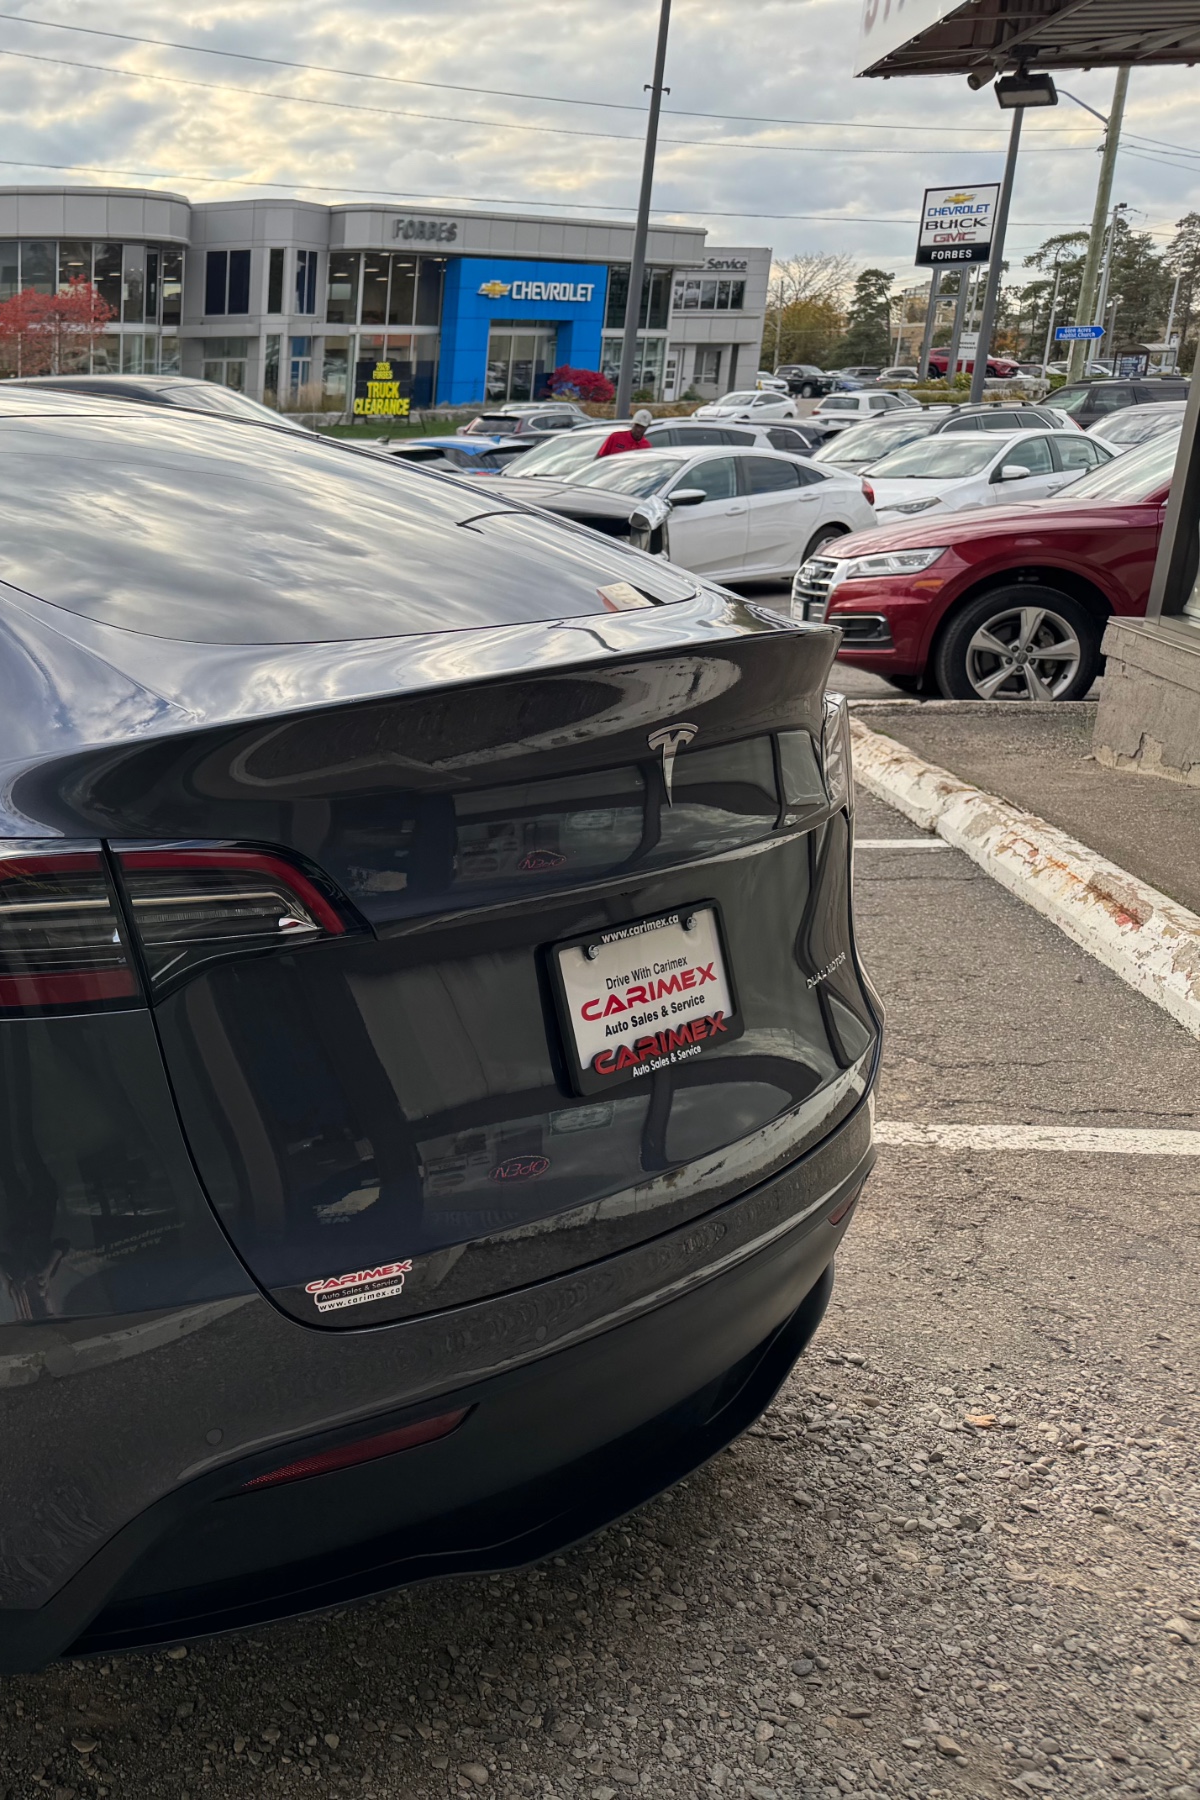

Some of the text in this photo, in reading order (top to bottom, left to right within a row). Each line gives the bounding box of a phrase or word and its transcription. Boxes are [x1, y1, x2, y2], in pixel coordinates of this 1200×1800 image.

[927, 203, 990, 217] CHEVROLET
[392, 219, 458, 243] FORBES
[925, 217, 988, 231] BUICK
[933, 231, 976, 243] GMC
[707, 258, 748, 269] Service
[931, 249, 972, 260] FORBES
[512, 281, 595, 302] CHEVROLET
[367, 381, 400, 399] TRUCK
[353, 398, 411, 416] CLEARANCE
[601, 914, 679, 944] www.carimex.ca
[605, 955, 688, 990] Drive With Carimex
[580, 962, 717, 1021] CARIMEX
[605, 994, 705, 1037] Auto Sales & Service
[593, 1011, 728, 1075] CARIMEX
[633, 1045, 702, 1078] Auto Sales & Service
[307, 1261, 411, 1292] CARIMEX
[319, 1287, 401, 1311] www.carimex.ca
[321, 1292, 340, 1300] Auto
[342, 1287, 363, 1296] Sales
[371, 1278, 399, 1290] Service
